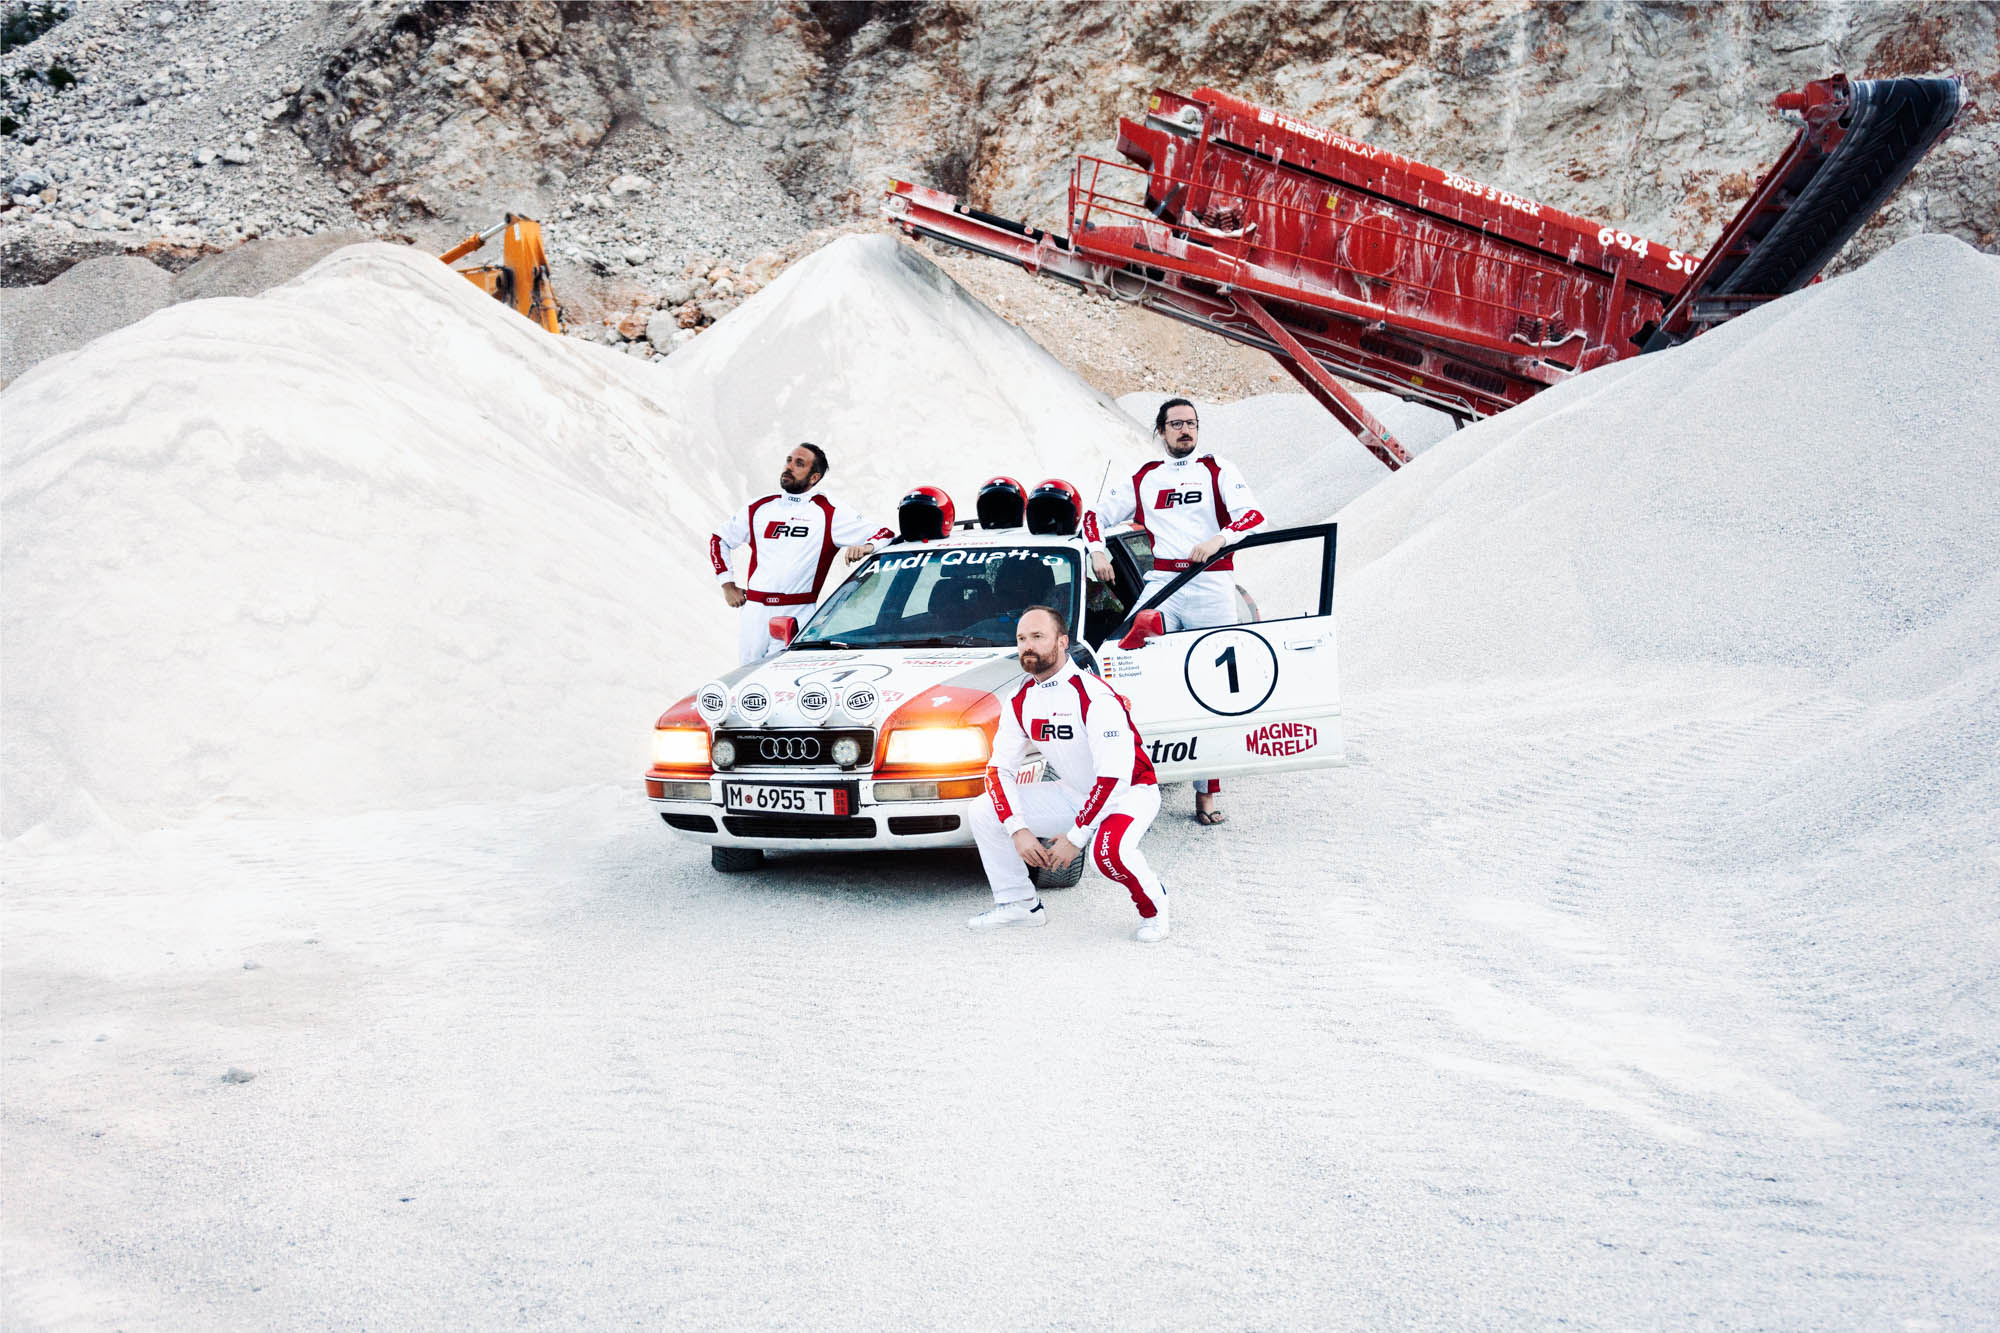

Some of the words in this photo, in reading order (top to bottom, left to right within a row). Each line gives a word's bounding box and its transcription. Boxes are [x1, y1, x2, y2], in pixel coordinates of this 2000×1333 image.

[1277, 116, 1327, 144] TEREX
[1332, 137, 1378, 160] FINLAY
[1442, 173, 1483, 196] 20x5
[1485, 186, 1497, 201] 3
[1500, 193, 1540, 216] Deck
[1598, 227, 1649, 259] 694
[1666, 249, 1701, 275] Su
[1165, 491, 1203, 507] R8
[772, 526, 810, 538] R8
[858, 552, 934, 578] Audi
[1215, 646, 1240, 693] 1
[703, 697, 724, 709] HELLA
[743, 698, 767, 706] HELLA
[803, 696, 828, 705] HELLA
[848, 692, 875, 707] HELLA
[1041, 724, 1074, 740] R8
[1246, 723, 1318, 749] MAGNETI
[1147, 737, 1198, 764] trol
[1246, 733, 1318, 757] MARELLI
[730, 786, 743, 807] M
[757, 788, 805, 811] 6955
[814, 791, 827, 812] T
[1091, 784, 1104, 803] sport
[1100, 831, 1112, 857] Sport
[1102, 858, 1120, 879] Audi
